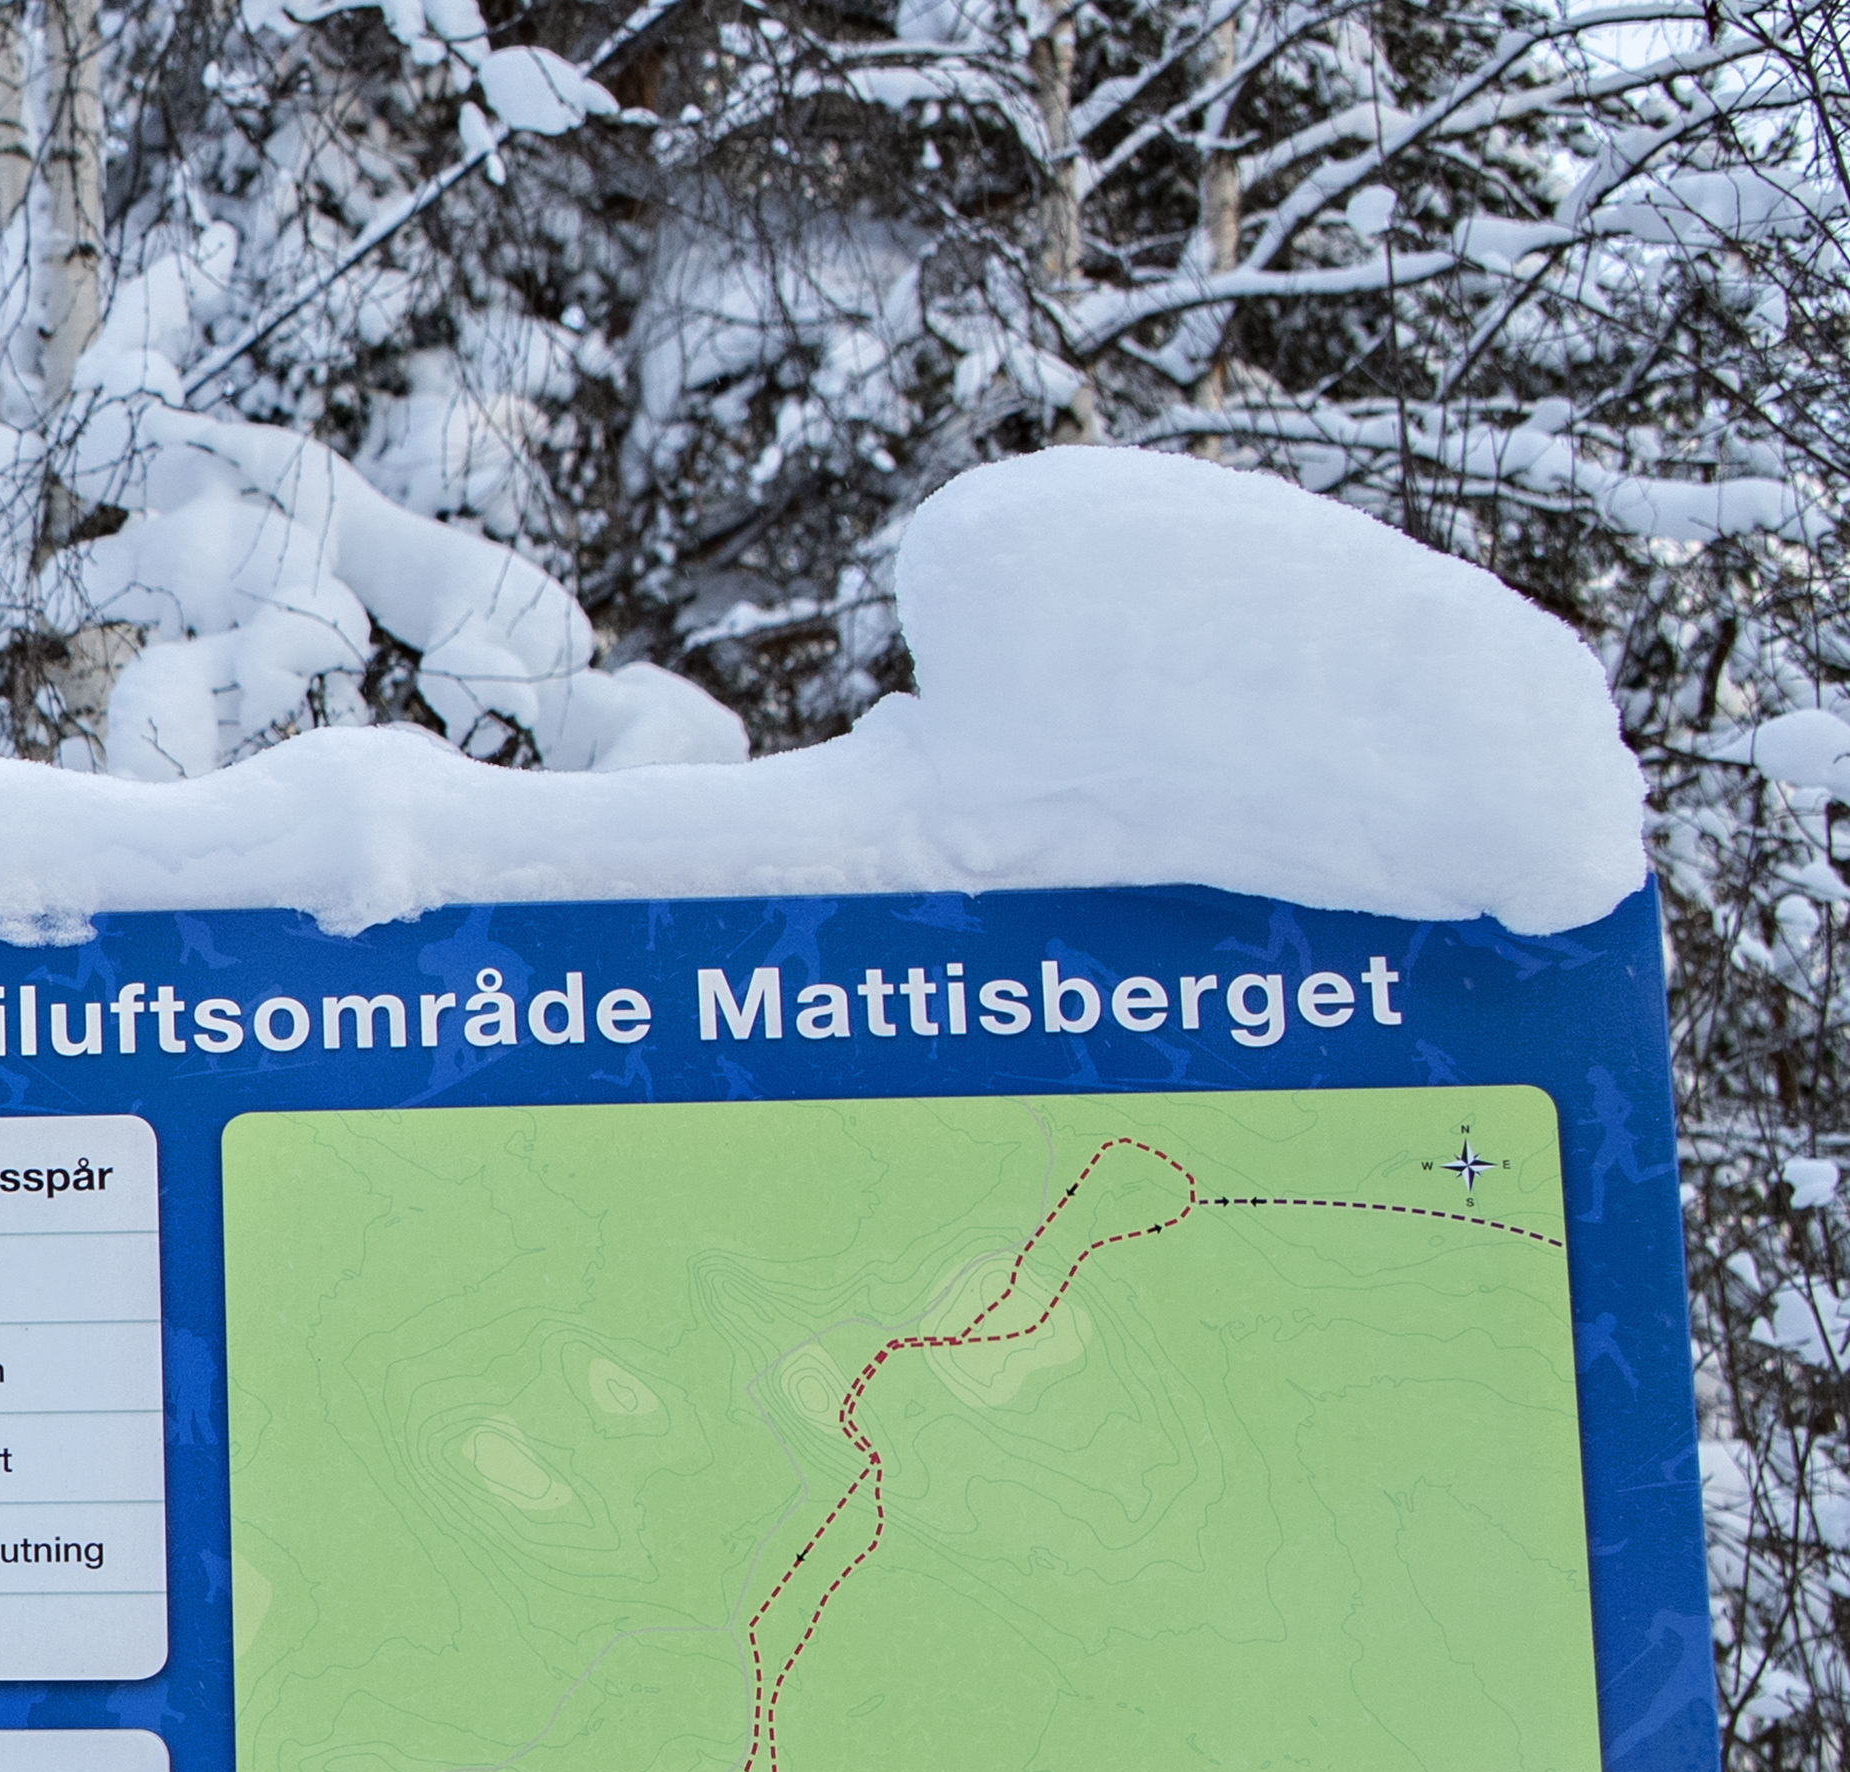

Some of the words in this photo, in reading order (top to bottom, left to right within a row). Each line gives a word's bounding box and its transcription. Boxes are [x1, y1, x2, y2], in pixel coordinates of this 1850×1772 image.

[697, 955, 1403, 1047] Mattisberget
[1460, 1124, 1470, 1134] N
[1421, 1161, 1433, 1171] W
[1502, 1159, 1511, 1170] E
[1466, 1197, 1475, 1208] S
